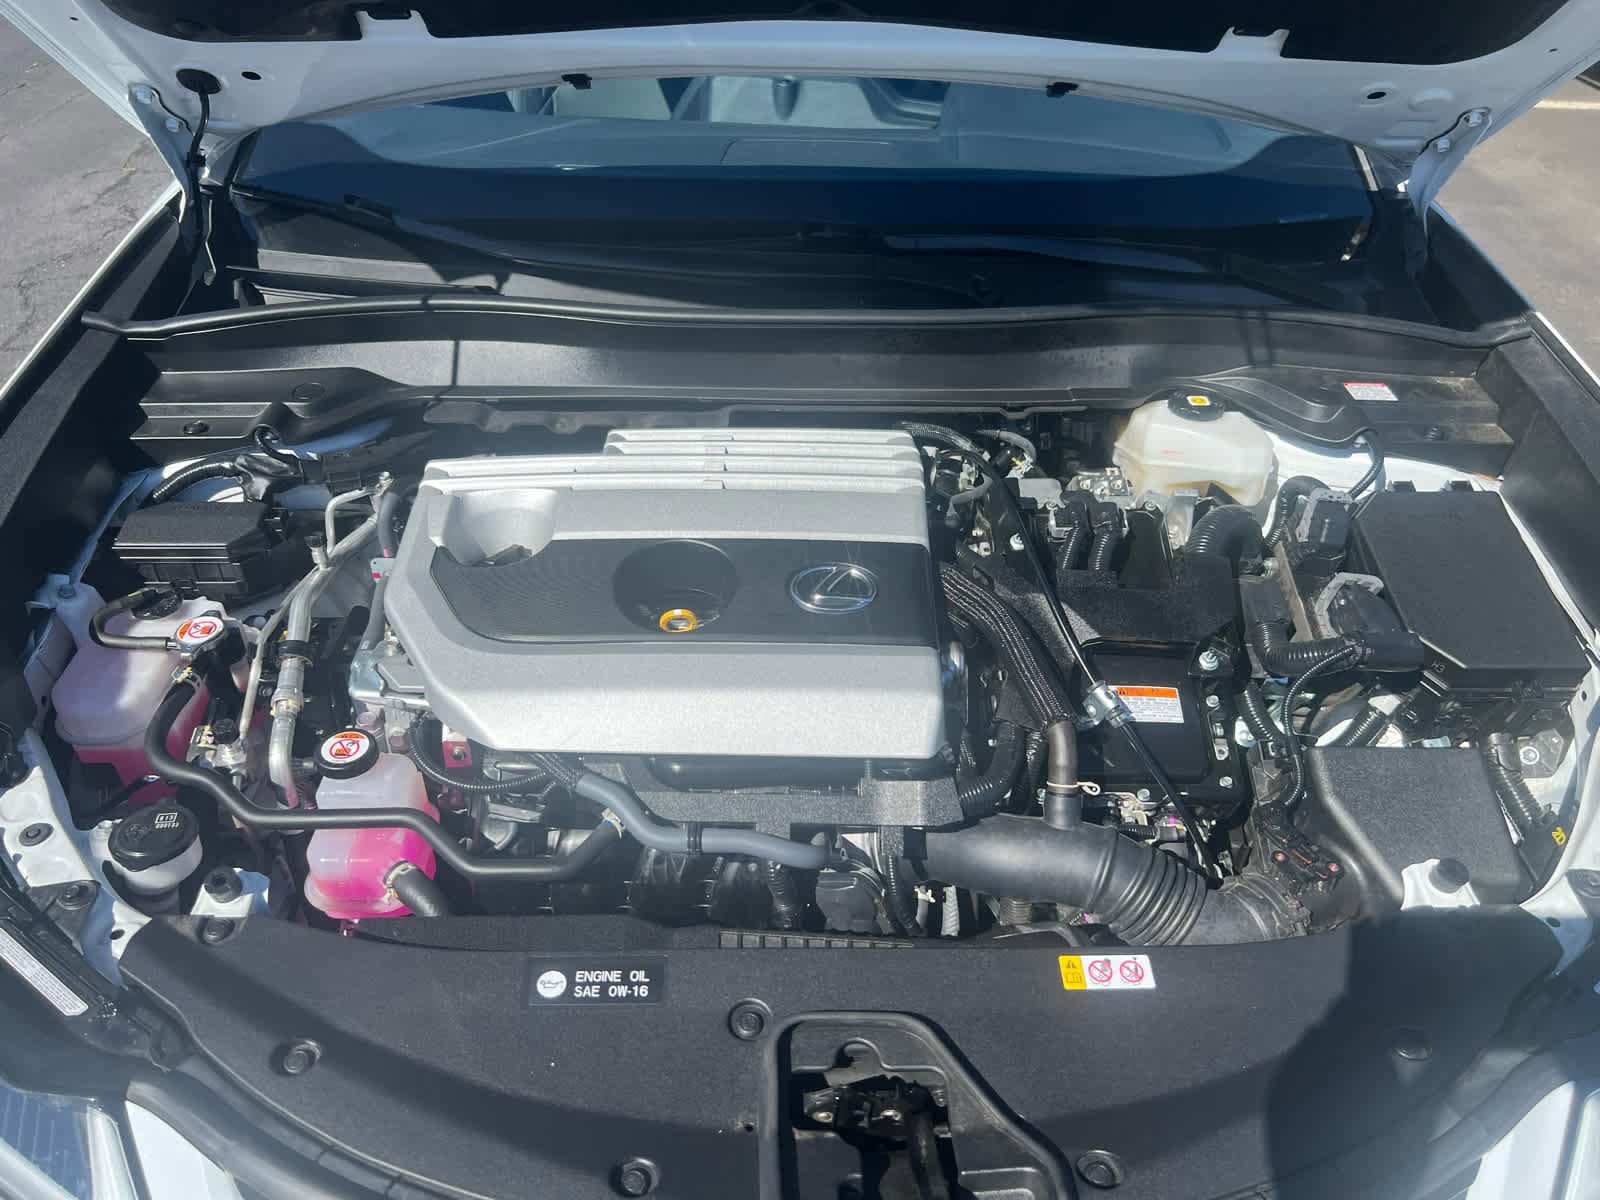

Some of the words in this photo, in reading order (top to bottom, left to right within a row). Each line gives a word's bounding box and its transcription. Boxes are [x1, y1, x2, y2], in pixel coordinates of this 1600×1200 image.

[575, 970, 622, 982] ENGINE
[629, 970, 649, 982] OIL
[574, 985, 600, 997] SAE
[608, 985, 648, 997] 0W-16
